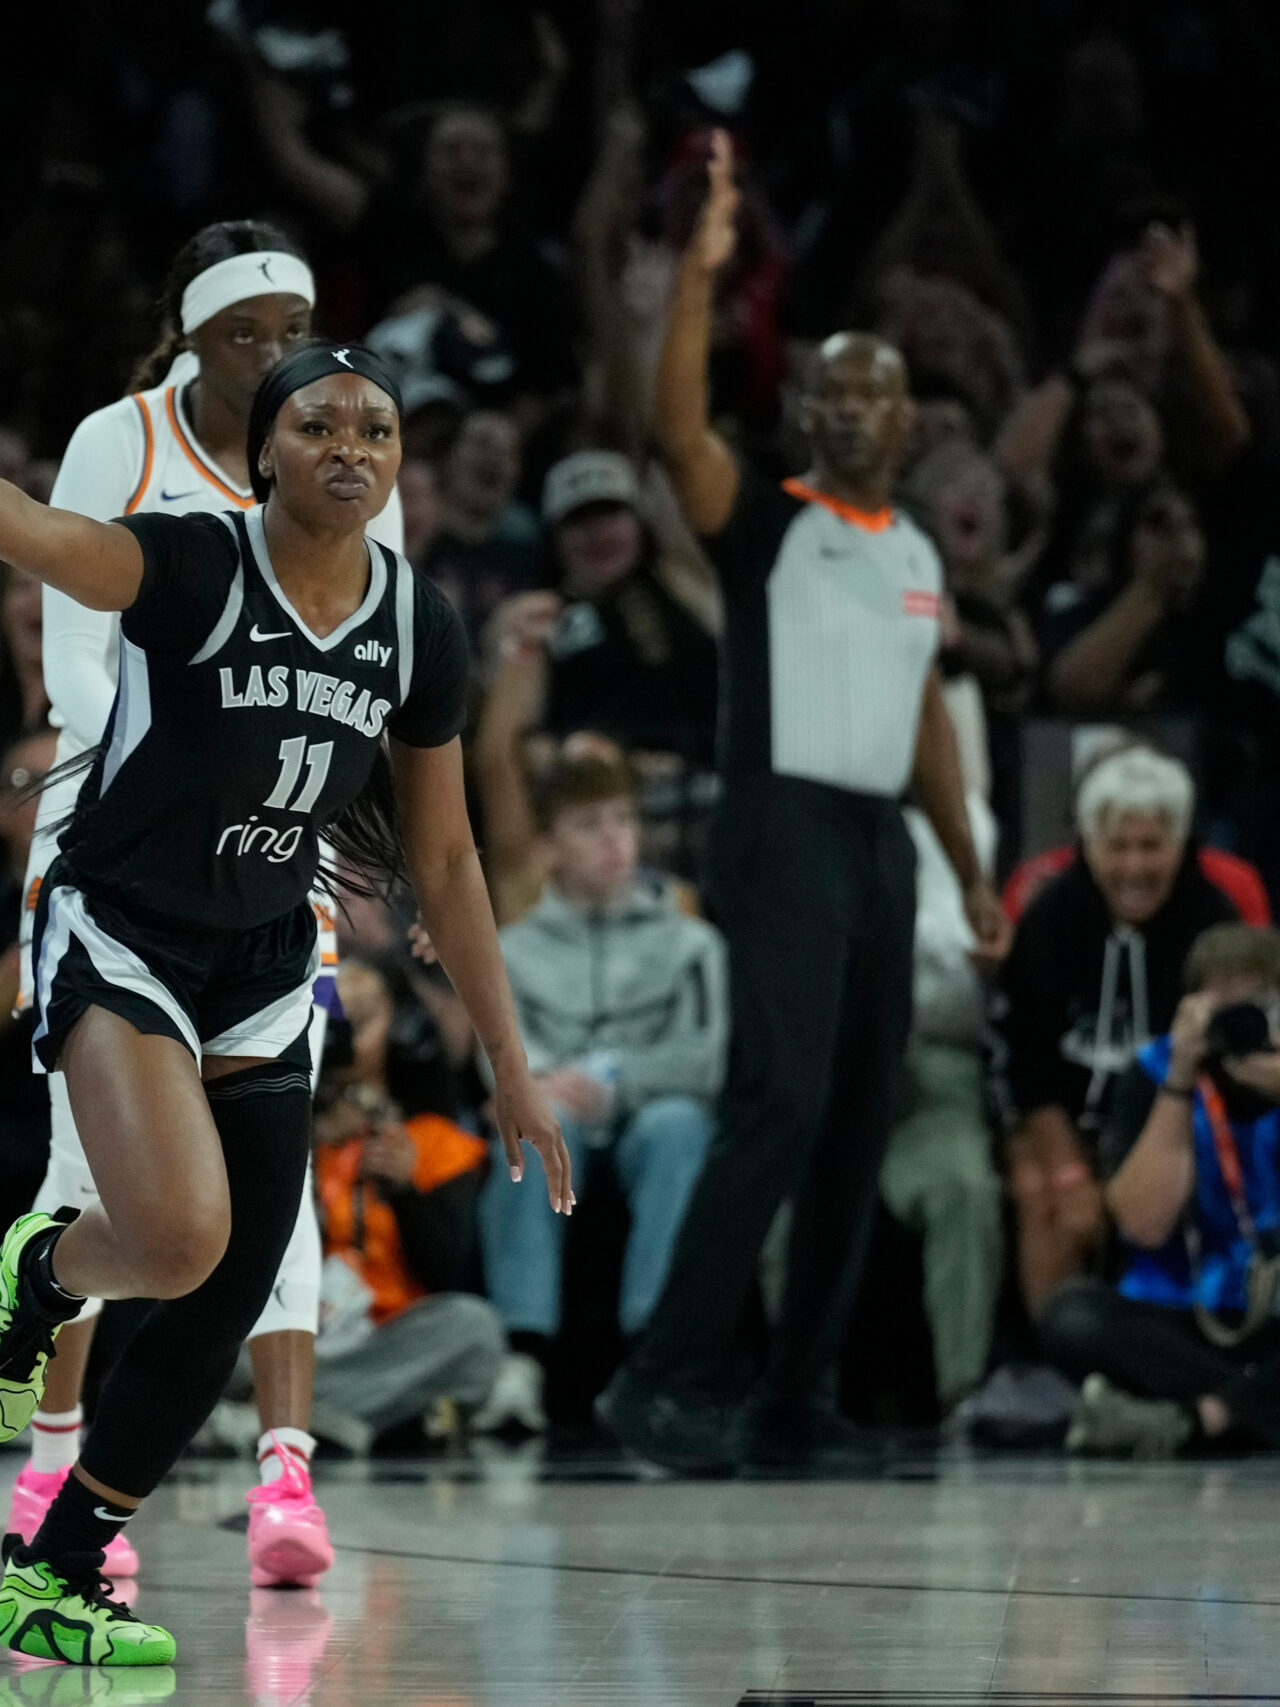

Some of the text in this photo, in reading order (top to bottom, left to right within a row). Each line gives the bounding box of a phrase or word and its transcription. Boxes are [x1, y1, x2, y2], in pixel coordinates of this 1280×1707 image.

[353, 640, 393, 667] ally
[219, 665, 392, 738] LAS VEGAS
[262, 735, 334, 814] 11
[215, 815, 303, 863] ring
